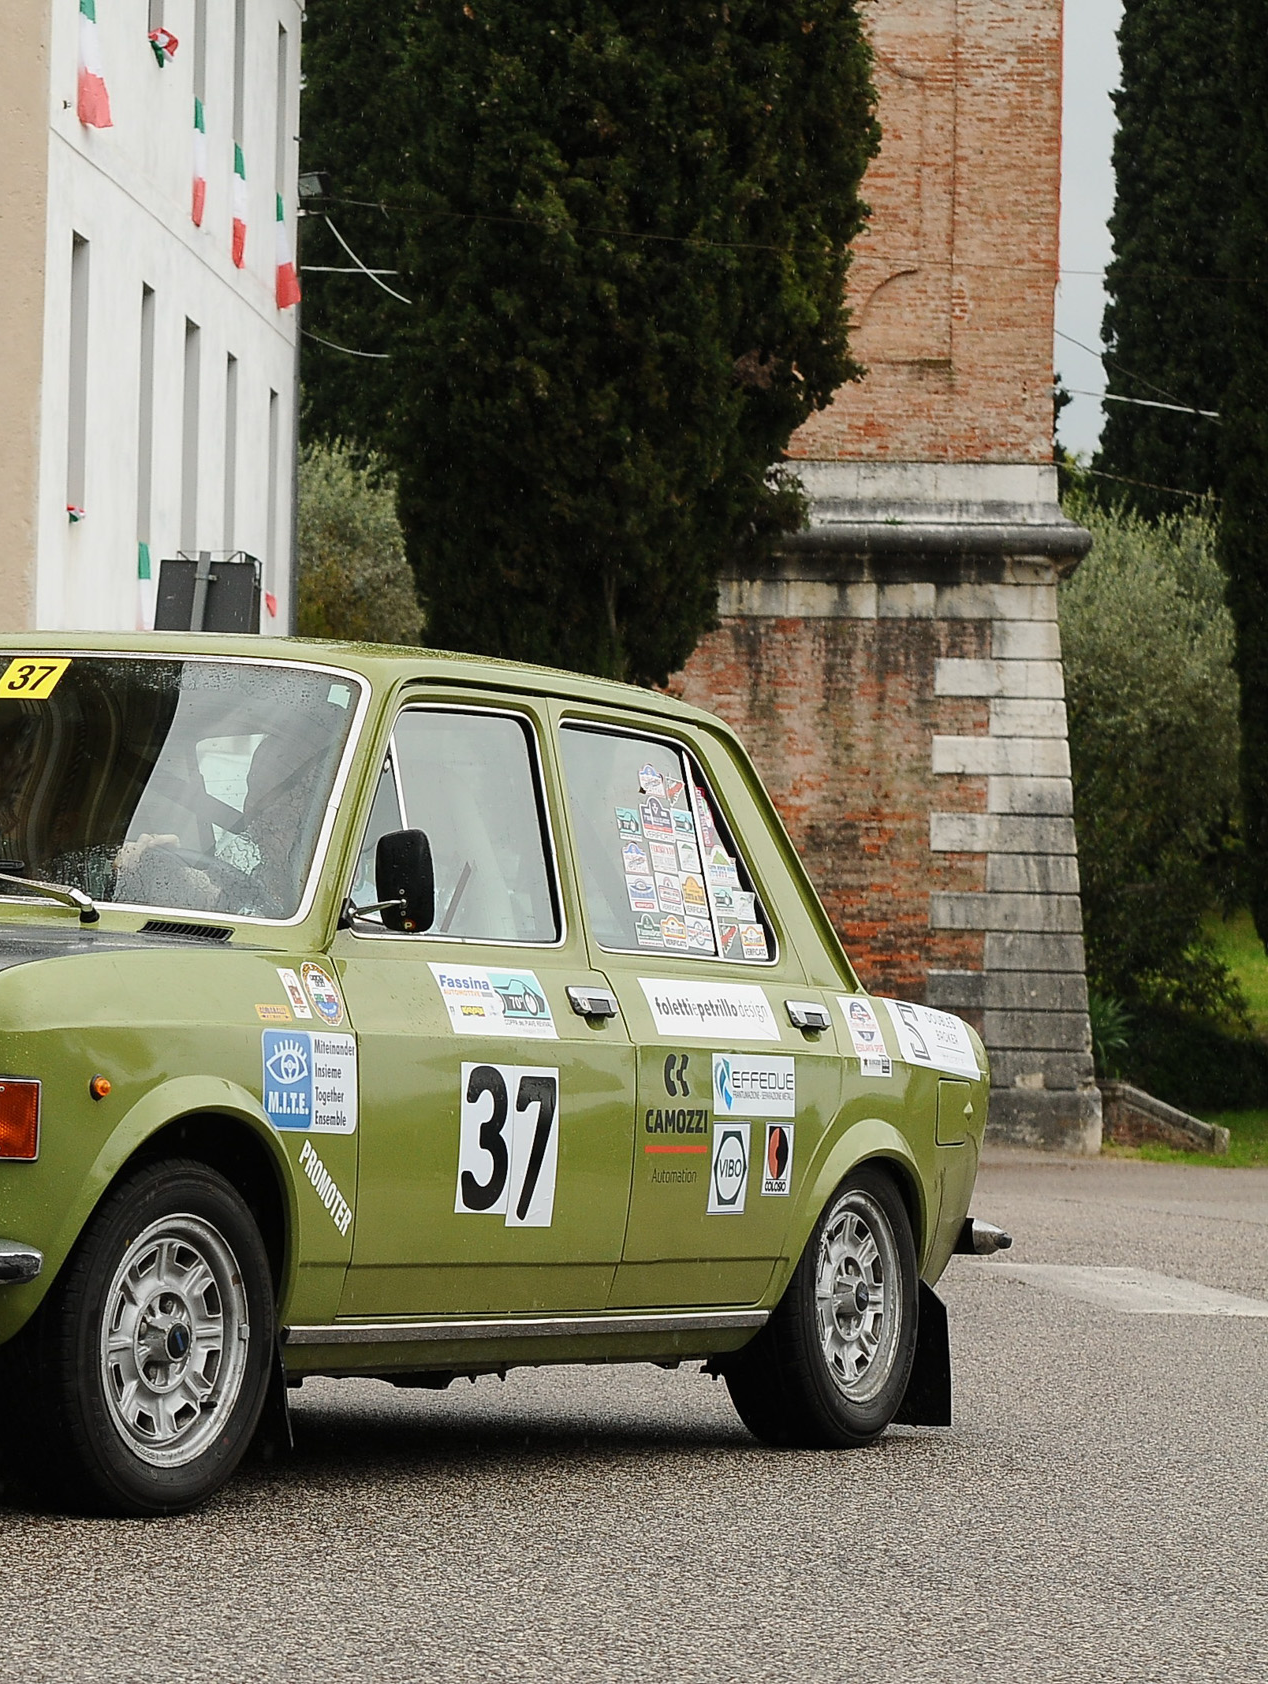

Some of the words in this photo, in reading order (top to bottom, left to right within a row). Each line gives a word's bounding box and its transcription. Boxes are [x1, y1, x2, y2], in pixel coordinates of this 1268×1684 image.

[7, 664, 58, 691] 37
[439, 974, 490, 991] Fassina
[314, 1039, 355, 1056] Miteinander
[314, 1062, 342, 1079] Insieme
[732, 1071, 794, 1091] EFFEDUE
[267, 1090, 310, 1115] M.I.T.E.
[315, 1086, 345, 1106] Together
[315, 1110, 347, 1126] Ensemble
[645, 1108, 708, 1134] CAMOZZI
[461, 1065, 557, 1221] 37
[651, 1167, 697, 1184] Automation
[719, 1158, 742, 1178] VIBO
[298, 1138, 353, 1237] PROMOTER
